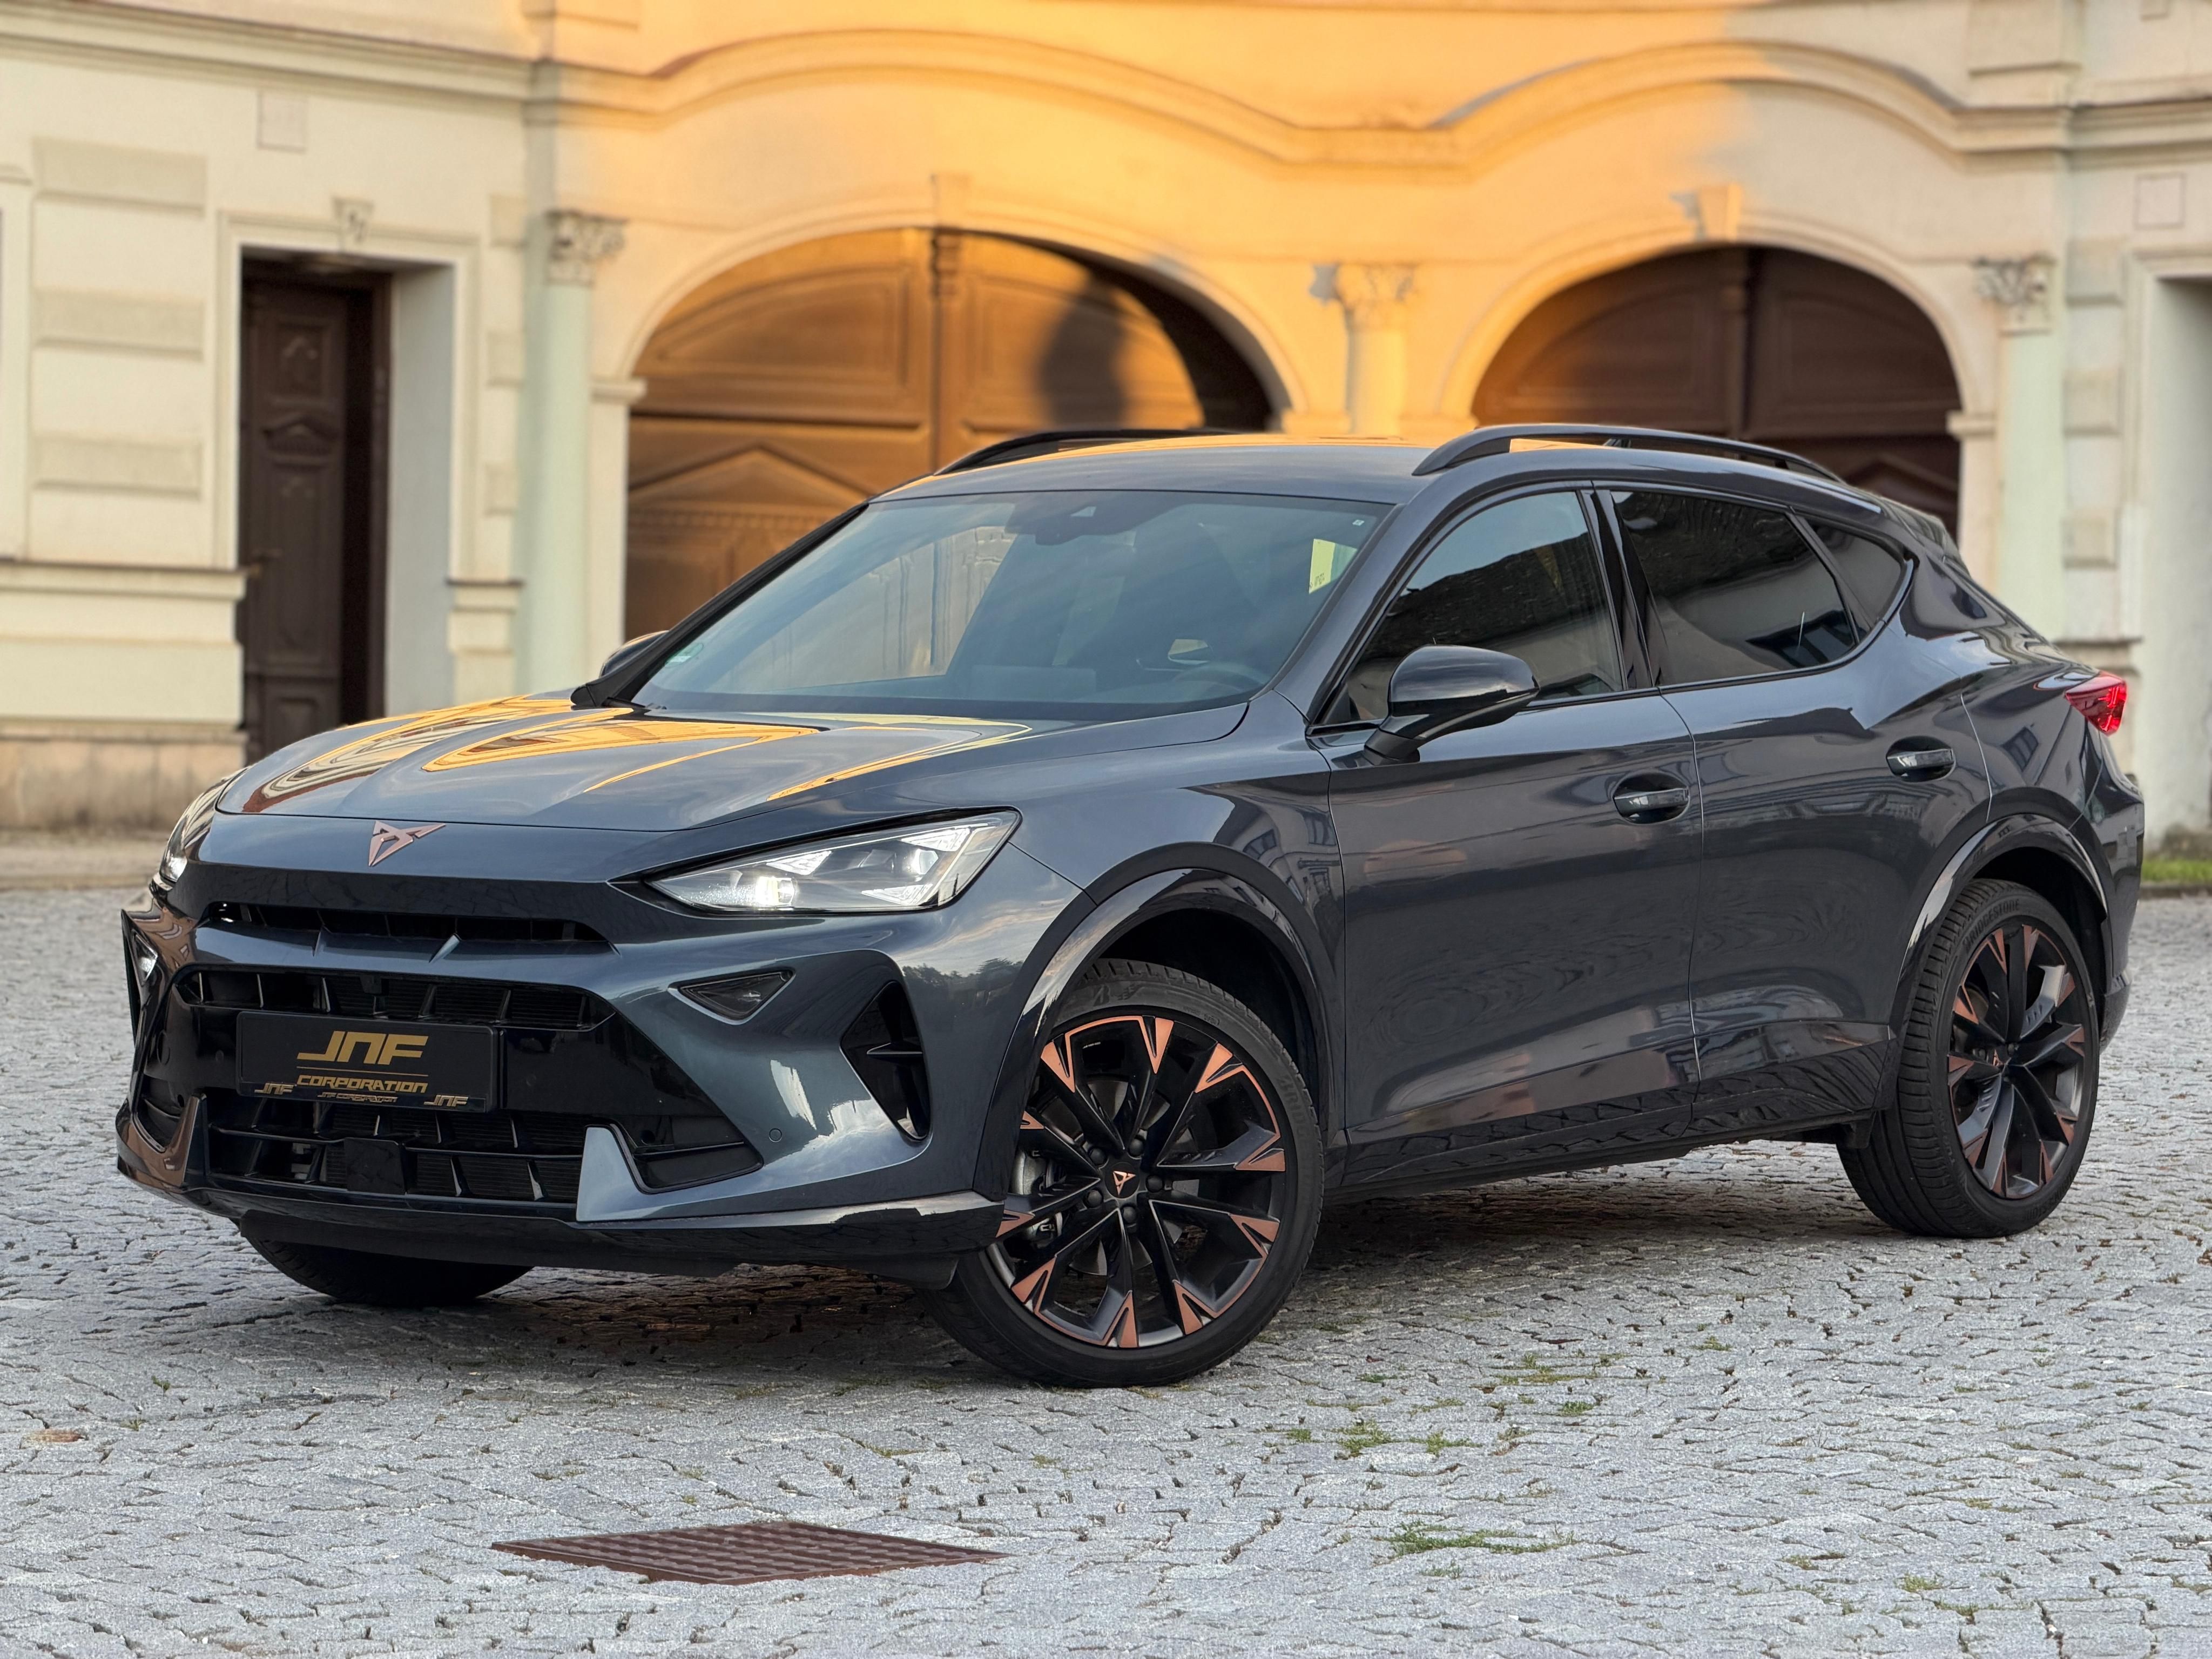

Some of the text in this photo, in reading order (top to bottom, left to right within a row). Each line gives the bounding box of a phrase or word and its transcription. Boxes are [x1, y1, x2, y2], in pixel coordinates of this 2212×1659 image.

[1962, 898, 2020, 953] BRIDGESTONE
[296, 1030, 429, 1065] JNF
[296, 1075, 429, 1094] CORPORATION
